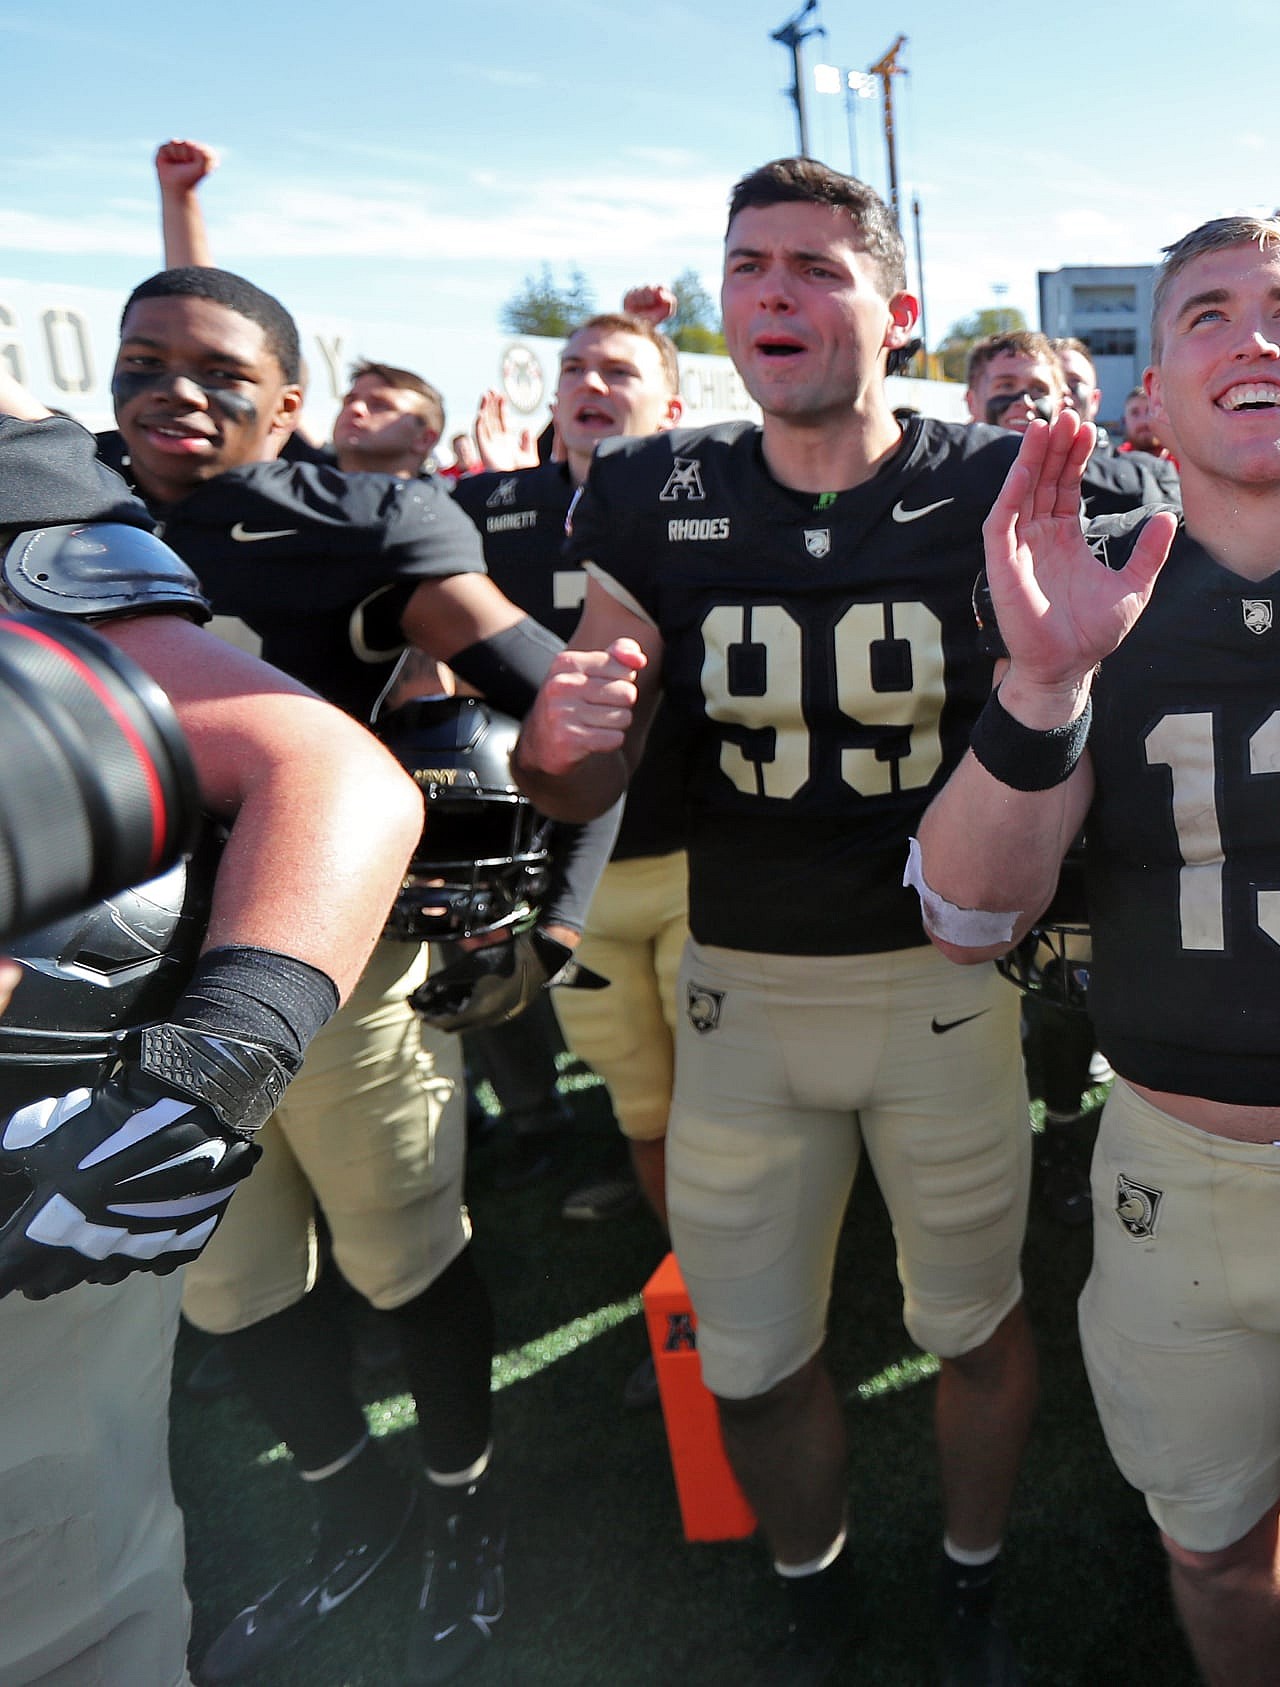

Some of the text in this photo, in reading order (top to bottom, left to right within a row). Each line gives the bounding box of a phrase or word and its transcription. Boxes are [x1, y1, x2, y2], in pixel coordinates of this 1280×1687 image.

[486, 510, 537, 533] BARNETT
[668, 517, 730, 542] RHODES
[700, 601, 946, 800] 99
